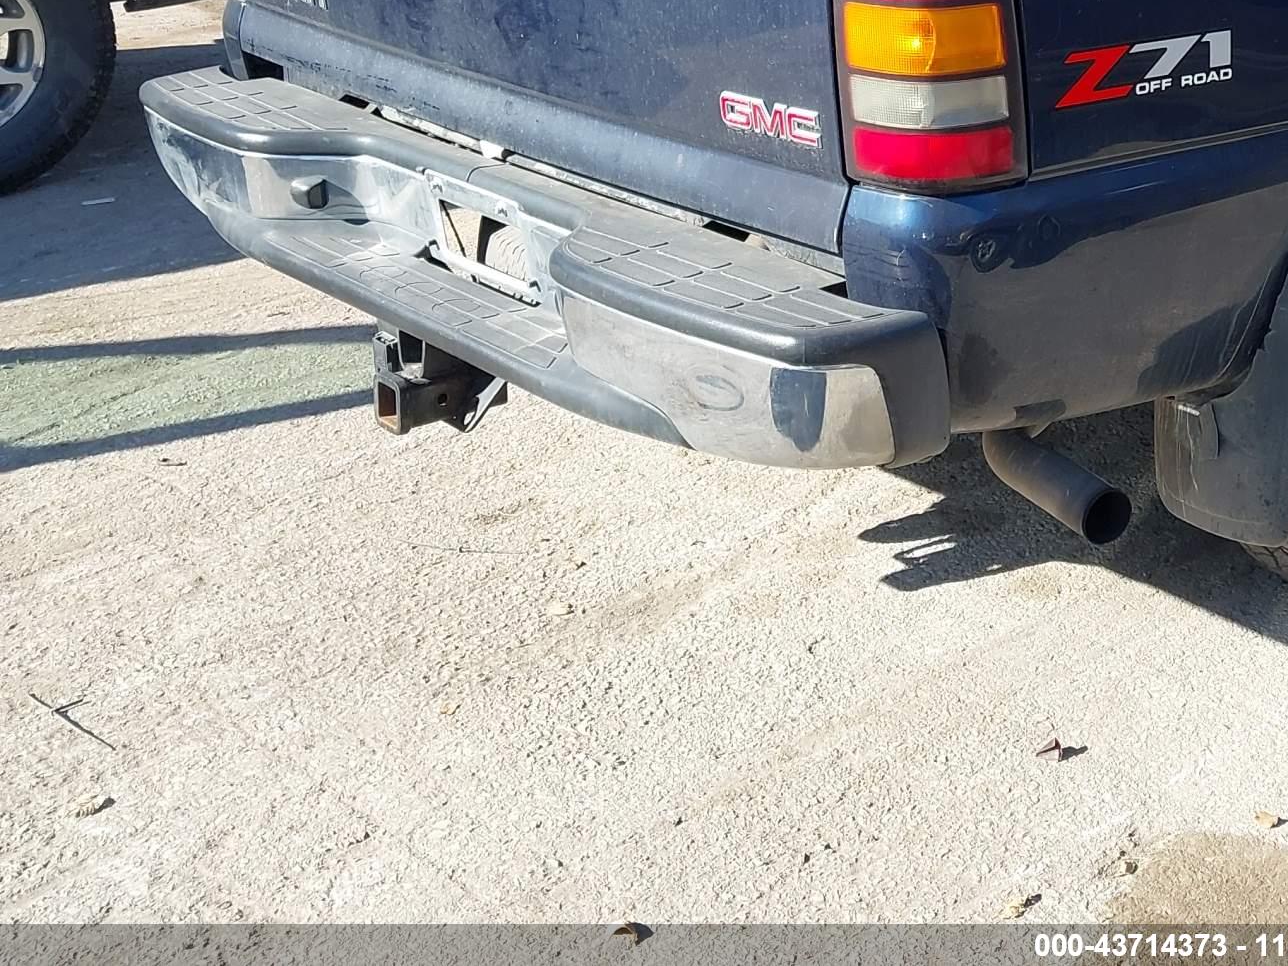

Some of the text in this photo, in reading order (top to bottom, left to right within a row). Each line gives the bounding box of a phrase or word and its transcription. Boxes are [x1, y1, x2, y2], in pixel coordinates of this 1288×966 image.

[1055, 29, 1232, 109] Z71
[1135, 68, 1233, 95] OFF ROAD
[720, 90, 822, 149] GMC
